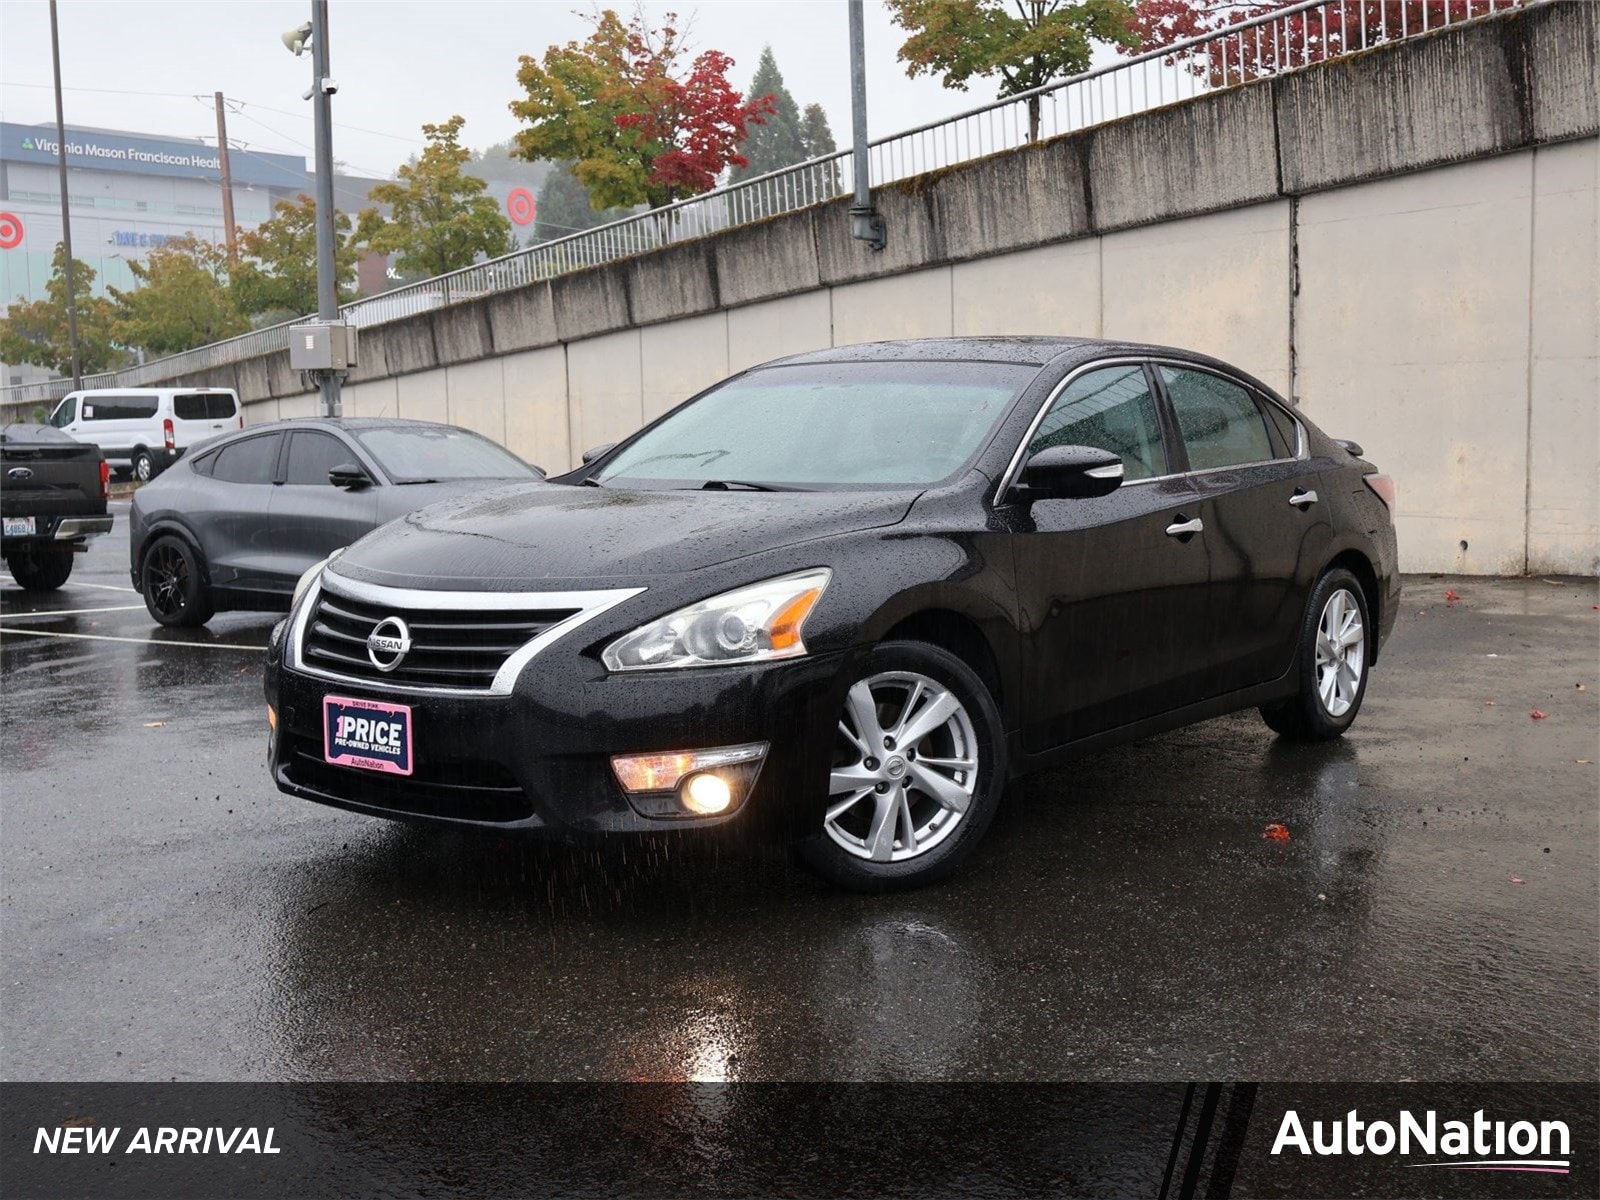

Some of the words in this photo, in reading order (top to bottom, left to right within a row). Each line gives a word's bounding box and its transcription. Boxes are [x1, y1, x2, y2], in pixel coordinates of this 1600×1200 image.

[34, 137, 83, 155] Virgnia
[85, 143, 126, 159] Mason
[128, 148, 190, 166] Franciscan
[191, 155, 221, 169] Healt
[369, 637, 402, 650] NISSAN
[334, 738, 370, 750] PRE-OWNED
[370, 743, 401, 755] VEHICLES
[351, 757, 385, 770] AutoNation
